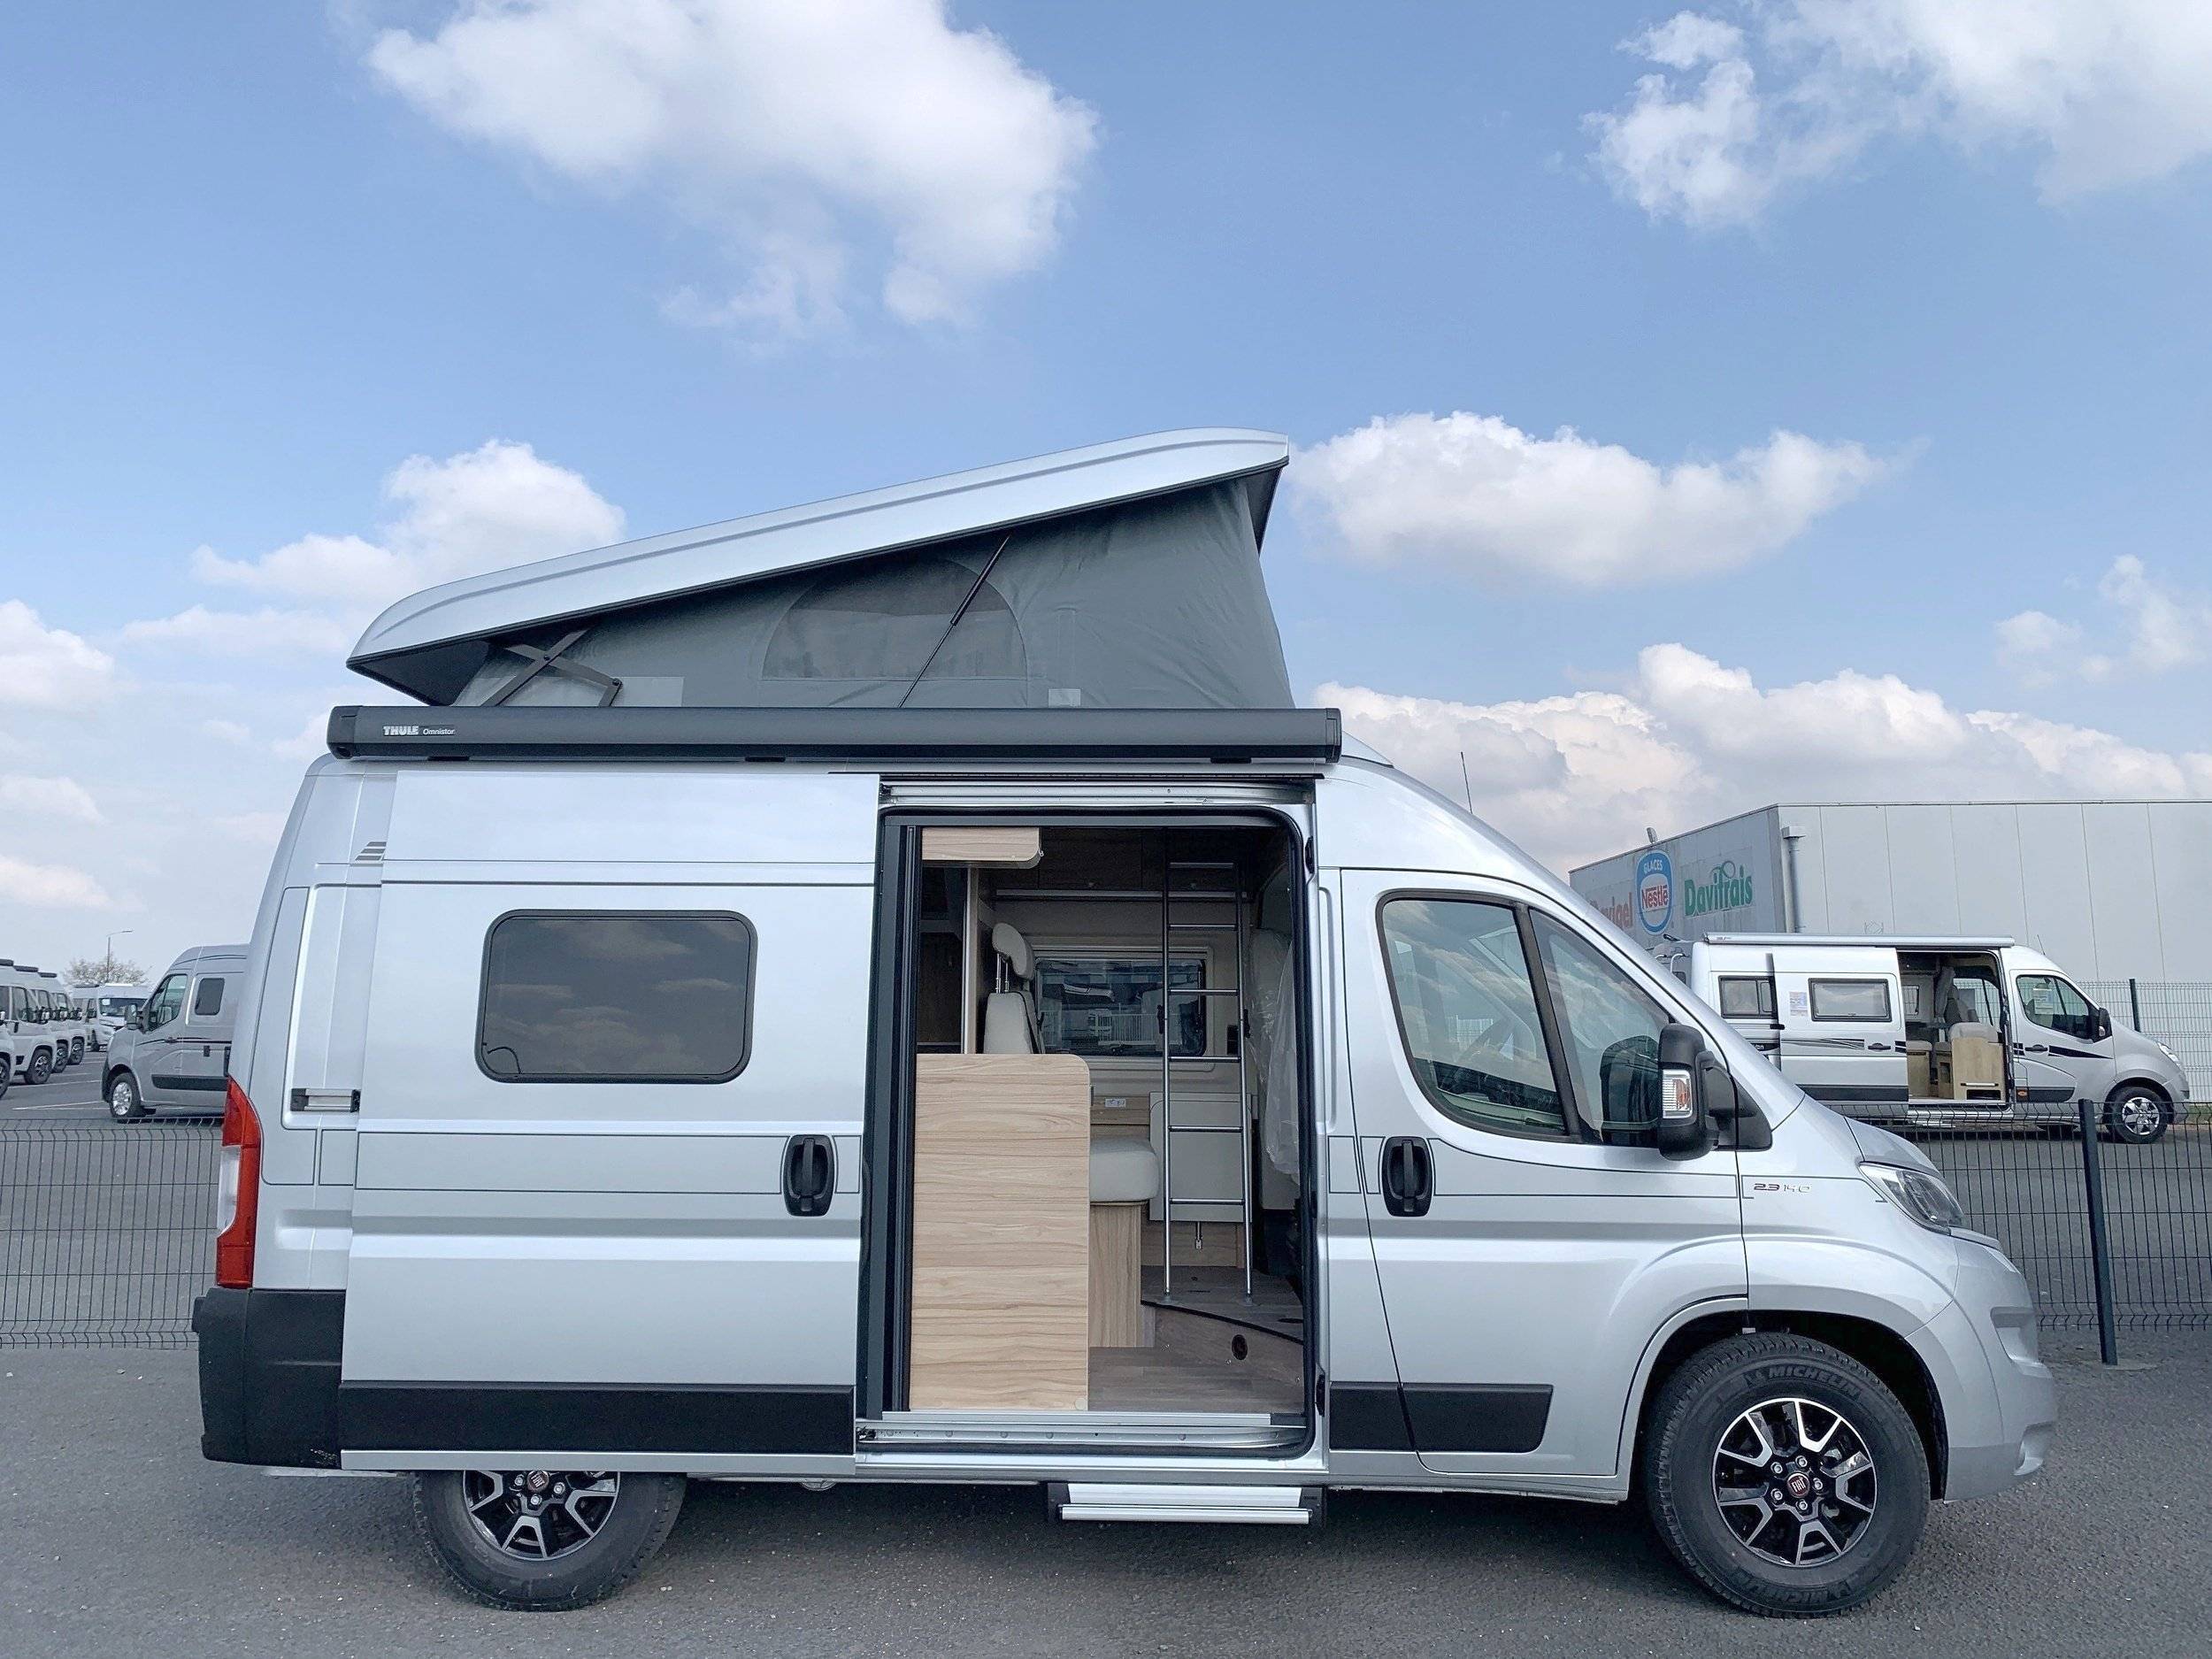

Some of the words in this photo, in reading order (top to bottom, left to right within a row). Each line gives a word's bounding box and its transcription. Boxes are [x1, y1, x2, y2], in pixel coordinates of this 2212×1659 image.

[383, 726, 419, 736] THULE
[1643, 859, 1663, 874] GLACES
[1684, 862, 1753, 917] Davifrais
[1769, 1364, 1863, 1398] MICHELIN
[1791, 1476, 1806, 1493] FIAT
